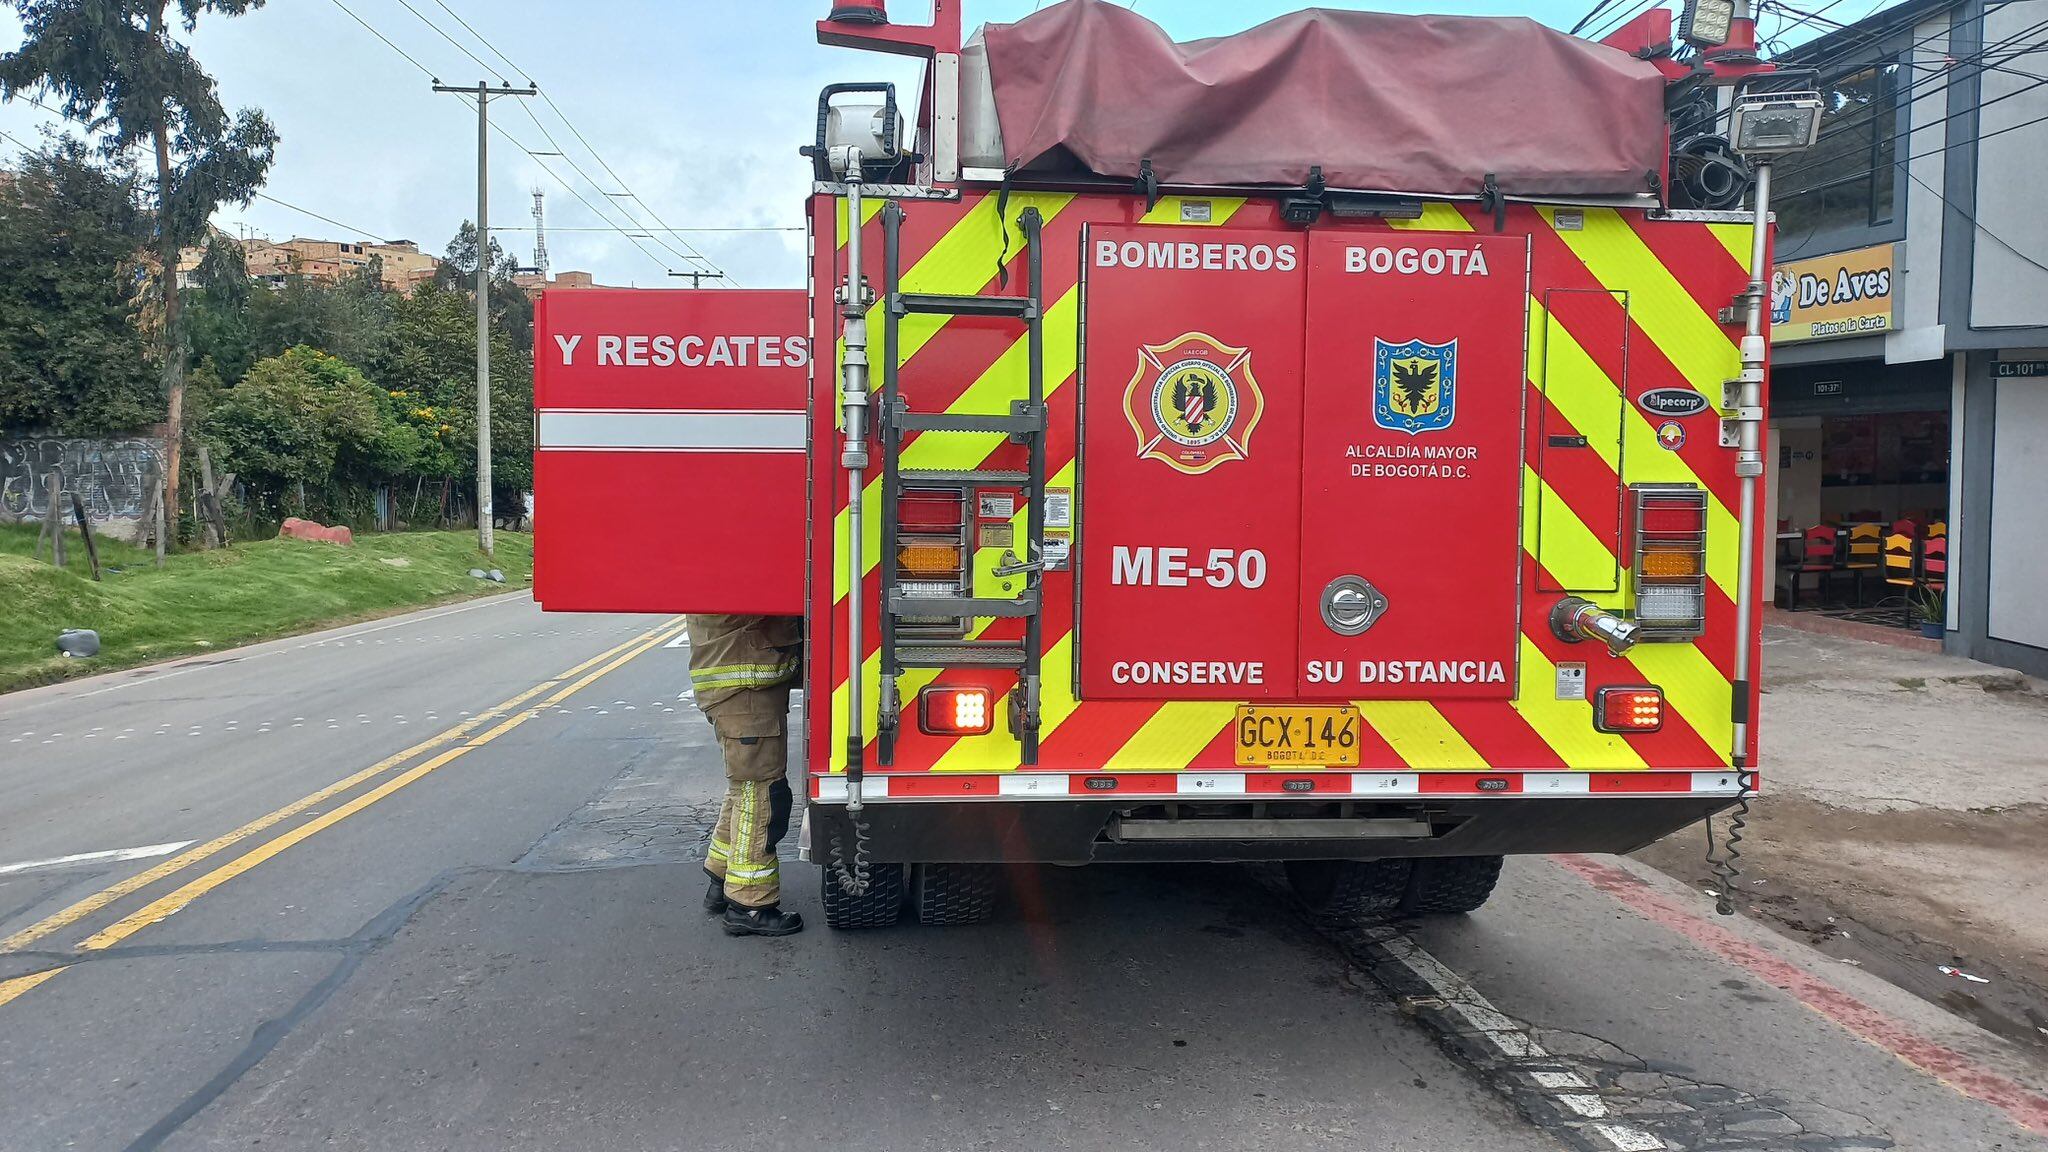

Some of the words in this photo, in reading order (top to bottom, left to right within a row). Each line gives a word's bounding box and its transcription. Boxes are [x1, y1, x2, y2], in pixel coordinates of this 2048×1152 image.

[1095, 240, 1297, 272] BOMBEROS
[1344, 243, 1490, 276] BOGOTÁ
[1798, 272, 1830, 309] De
[1831, 266, 1891, 305] Aves
[1811, 321, 1839, 337] Platos
[1839, 323, 1847, 333] a
[1847, 318, 1857, 331] la
[1857, 315, 1886, 330] Carta
[554, 335, 583, 366] Y
[597, 335, 807, 367] RESCATES
[2016, 363, 2034, 375] 101
[1345, 443, 1421, 459] ALCALDÍA
[1424, 446, 1478, 460] MAYOR
[1351, 463, 1373, 477] DE
[1374, 461, 1439, 478] BOGOTÁ
[1442, 463, 1471, 478] D.C.
[1111, 546, 1267, 589] ME-50
[1111, 661, 1264, 685] CONSERVE
[1306, 660, 1343, 683] SU
[1359, 660, 1506, 684] DISTANCIA
[1240, 715, 1293, 748] GCX
[1304, 716, 1355, 748] 146
